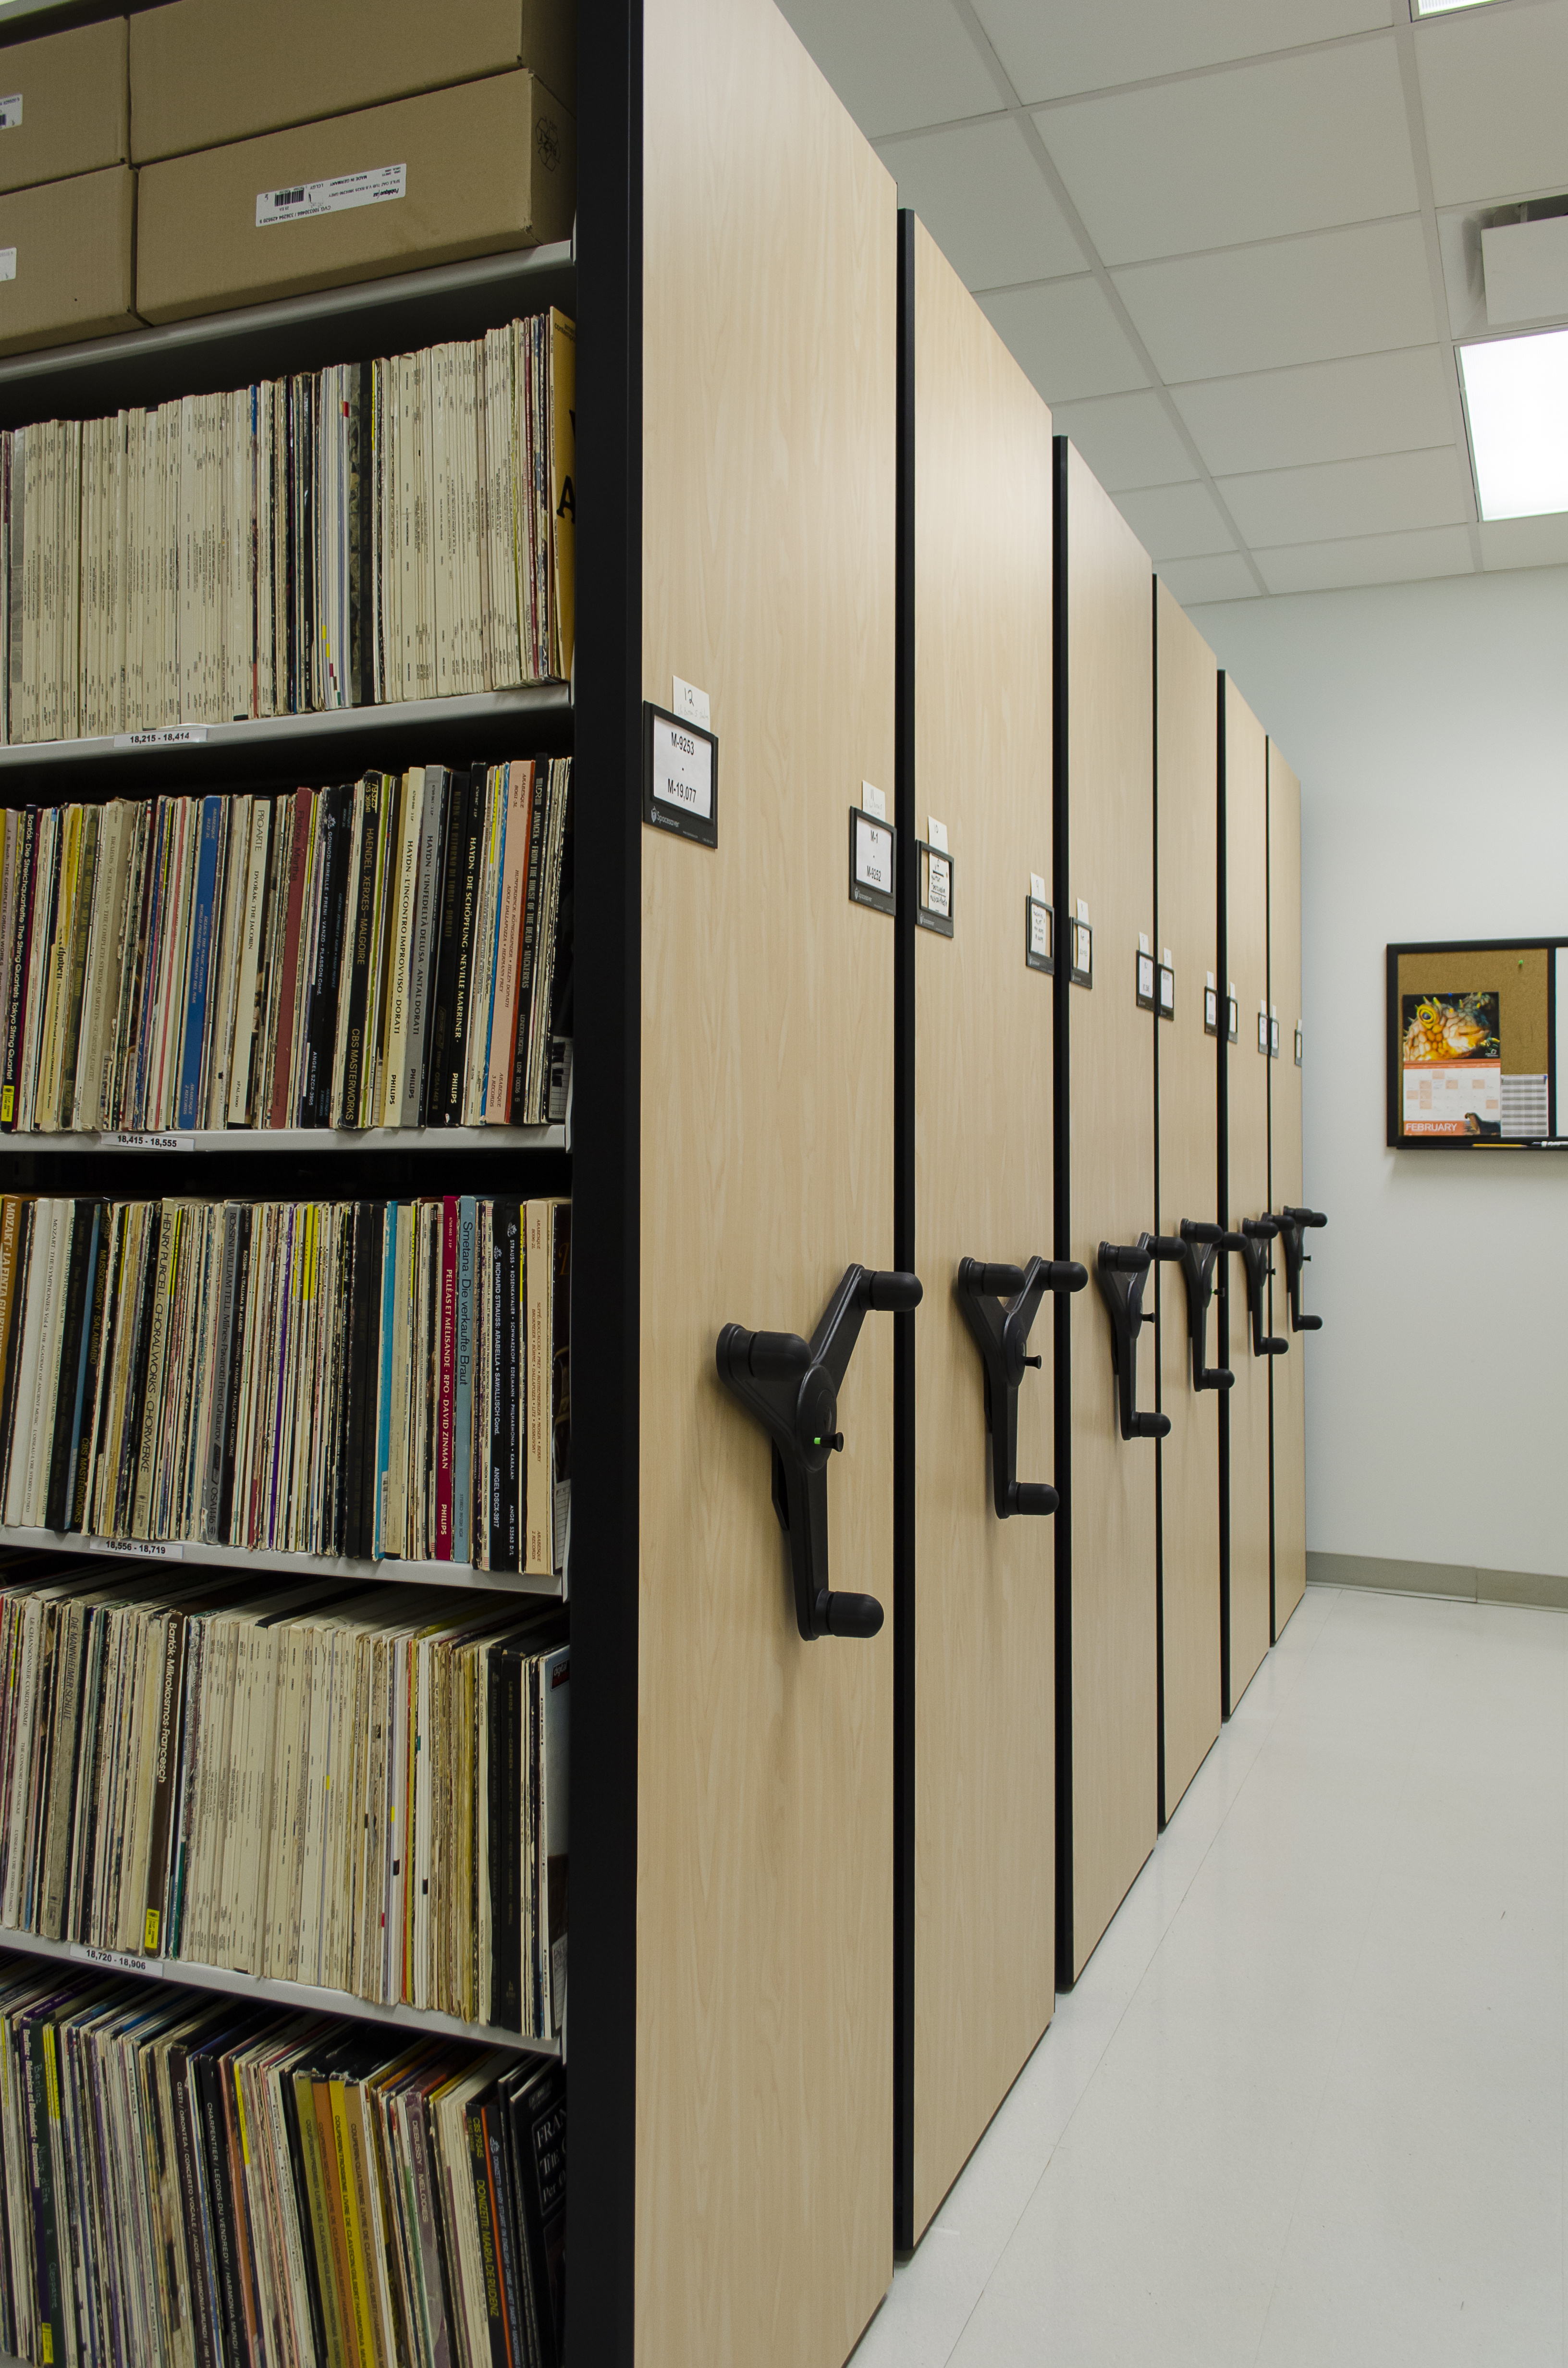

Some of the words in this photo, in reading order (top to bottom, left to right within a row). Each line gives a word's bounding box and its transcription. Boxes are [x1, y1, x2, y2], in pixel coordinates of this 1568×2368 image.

[684, 687, 695, 707] 12
[130, 734, 156, 744] 18,215
[163, 732, 190, 741] 18,414
[671, 731, 695, 756] M-9253
[668, 778, 697, 803] M-19,077
[25, 814, 34, 840] Bartók
[294, 810, 305, 843] Flotow
[657, 811, 680, 827] Spacesaver
[290, 847, 302, 882] Martha
[363, 827, 374, 874] HAENDEL:
[404, 840, 413, 873] HAYDN
[425, 835, 433, 867] HAYDN
[467, 837, 476, 869] HAYDN
[530, 845, 539, 864] FROM
[529, 865, 537, 878] THE
[867, 865, 882, 882] M-9252
[18, 858, 30, 923] Streichquartette
[400, 878, 410, 934] L'INCONTRO
[420, 874, 432, 927] L'INFEDELTÀ
[527, 879, 536, 900] HOUSE
[461, 892, 474, 948] SCHÖPFUNG
[526, 912, 534, 925] THE
[527, 902, 534, 911] OF
[417, 928, 426, 962] DELUSA
[508, 914, 517, 958] KÖNIGSKINDER
[525, 926, 533, 943] DEAD
[14, 940, 23, 963] String
[396, 936, 406, 993] IMPROVVISO
[12, 963, 21, 998] Quartets
[415, 969, 423, 999] ANTAL
[458, 954, 466, 989] NEVILLE
[521, 950, 531, 988] MACKERRAS
[9, 1001, 18, 1024] Tokyo
[393, 999, 402, 1034] DORATI
[412, 999, 421, 1035] DORATI
[454, 990, 465, 1038] MARRINER
[7, 1025, 16, 1048] String
[350, 1028, 360, 1048] CBS
[5, 1048, 15, 1080] Quartet
[345, 1049, 358, 1121] MASTERWORKS
[117, 1135, 143, 1146] 18,415
[150, 1138, 177, 1148] 18,555
[1406, 1122, 1458, 1131] FEBRUARY
[2, 1202, 16, 1248] MOZART
[160, 1212, 172, 1250] HENRY
[228, 1212, 237, 1247] ROSSINI
[2, 1252, 11, 1265] LA
[462, 1221, 473, 1271] Smetana
[94, 1249, 107, 1309] MUSSORGSKY
[156, 1251, 168, 1299] PURCELL
[225, 1248, 234, 1288] WILLIAM
[223, 1289, 232, 1312] TELL
[445, 1269, 454, 1304] PELLÉAS
[461, 1279, 471, 1298] Die
[445, 1305, 451, 1315] ET
[460, 1301, 471, 1352] verkaufte
[89, 1315, 101, 1364] SALAMMBO
[151, 1303, 163, 1351] CHORAL
[443, 1317, 453, 1368] MÉLISANDE
[147, 1351, 159, 1394] WORKS
[459, 1355, 469, 1385] Braut
[140, 1400, 155, 1473] CHORWERKE
[105, 1540, 132, 1552] 18,556
[138, 1543, 166, 1555] 18,719
[29, 1617, 35, 1625] LE
[70, 1616, 79, 1630] DIE
[25, 1627, 34, 1679] CHANSONNIER
[65, 1631, 78, 1688] MANNHEIMER
[22, 1680, 31, 1727] CORDIFORME
[62, 1689, 74, 1720] SCHULE
[85, 1949, 112, 1963] 18,720
[118, 1957, 147, 1971] 18,906
[33, 2064, 45, 2104] Berlioz
[179, 2109, 188, 2147] ORONTEA
[207, 2102, 218, 2160] CHARPENTIER
[37, 2146, 48, 2172] Nuits
[184, 2153, 193, 2195] CONCERTO
[412, 2120, 422, 2165] DEBUSSY
[417, 2173, 429, 2222] MELODIES
[212, 2168, 222, 2201] LEÇONS
[188, 2196, 196, 2227] VOCALE
[218, 2203, 224, 2216] DU
[476, 2179, 490, 2229] DONIZETTI:
[219, 2217, 229, 2265] VENDREDY
[481, 2230, 493, 2263] MARIA
[485, 2264, 495, 2278] DE
[225, 2272, 235, 2319] HARMONIA
[486, 2277, 499, 2317] RUDENZ
[230, 2320, 238, 2349] MUNDI
